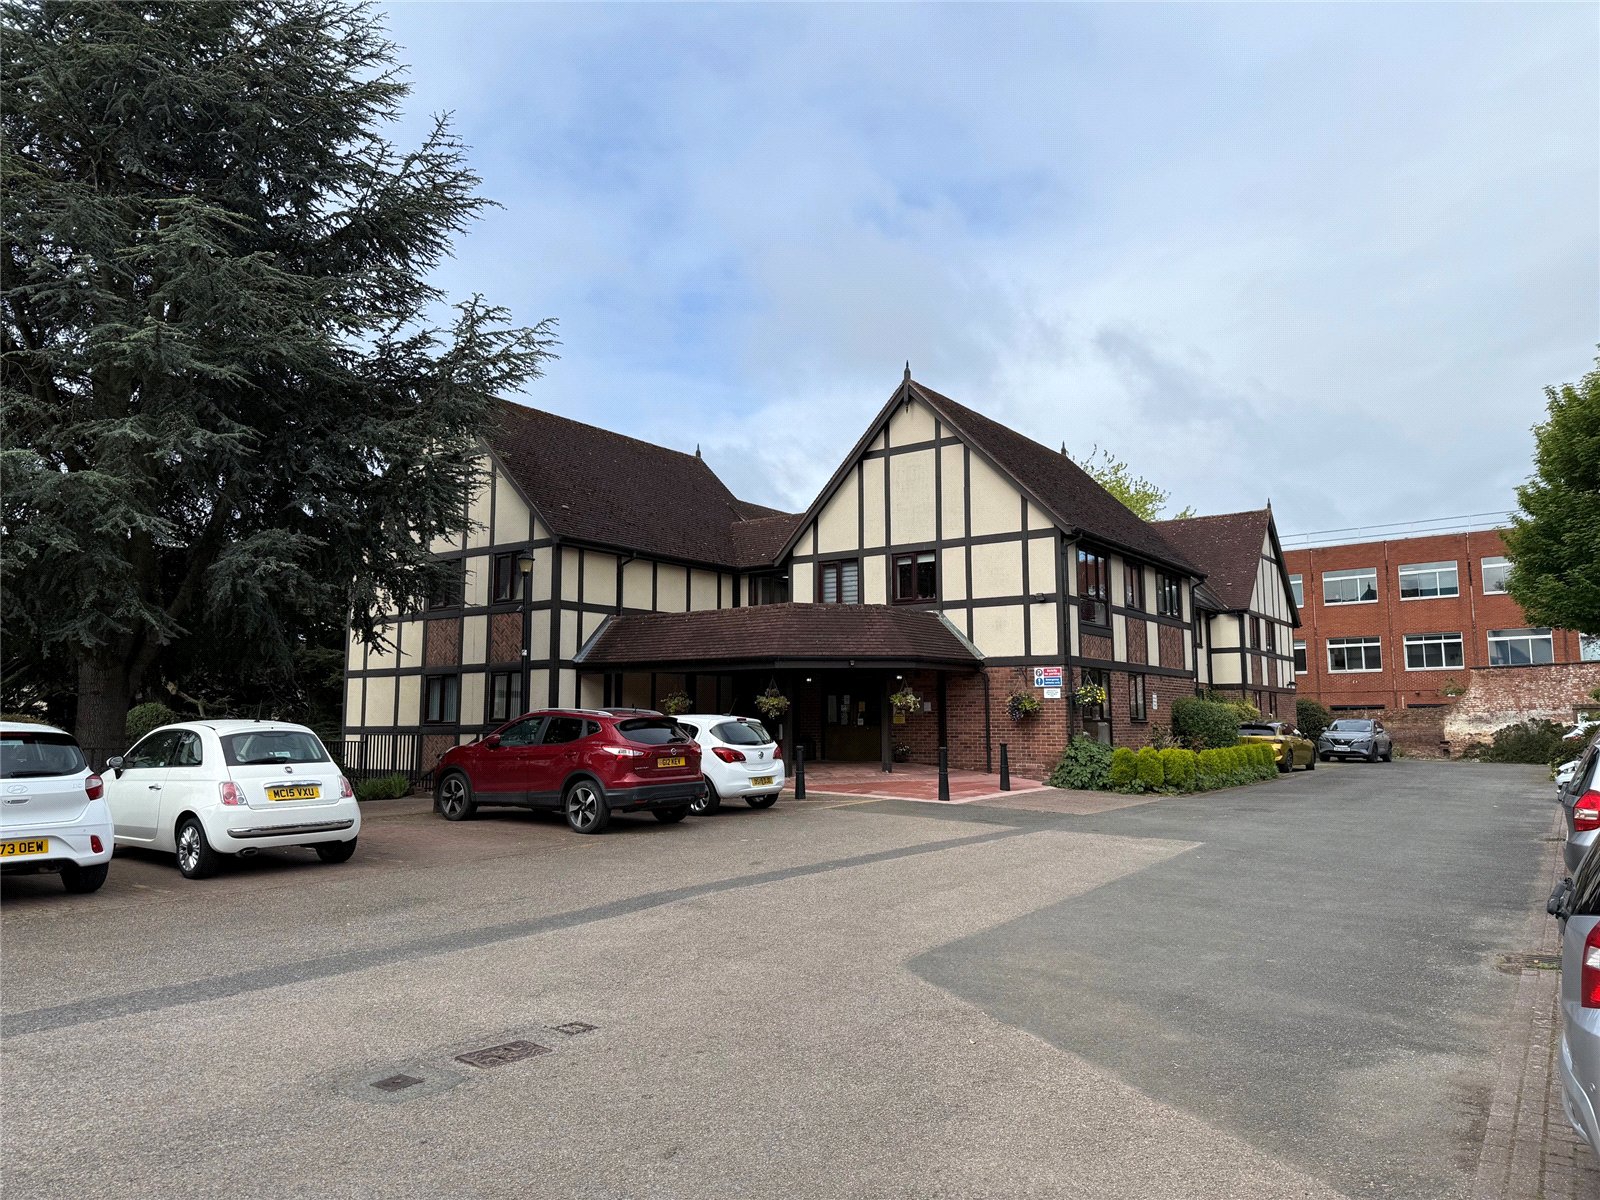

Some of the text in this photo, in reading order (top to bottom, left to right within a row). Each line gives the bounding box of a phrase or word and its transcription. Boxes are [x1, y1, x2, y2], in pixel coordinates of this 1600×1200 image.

[273, 787, 314, 798] MC15 VXU
[0, 841, 43, 855] 73 OEW
